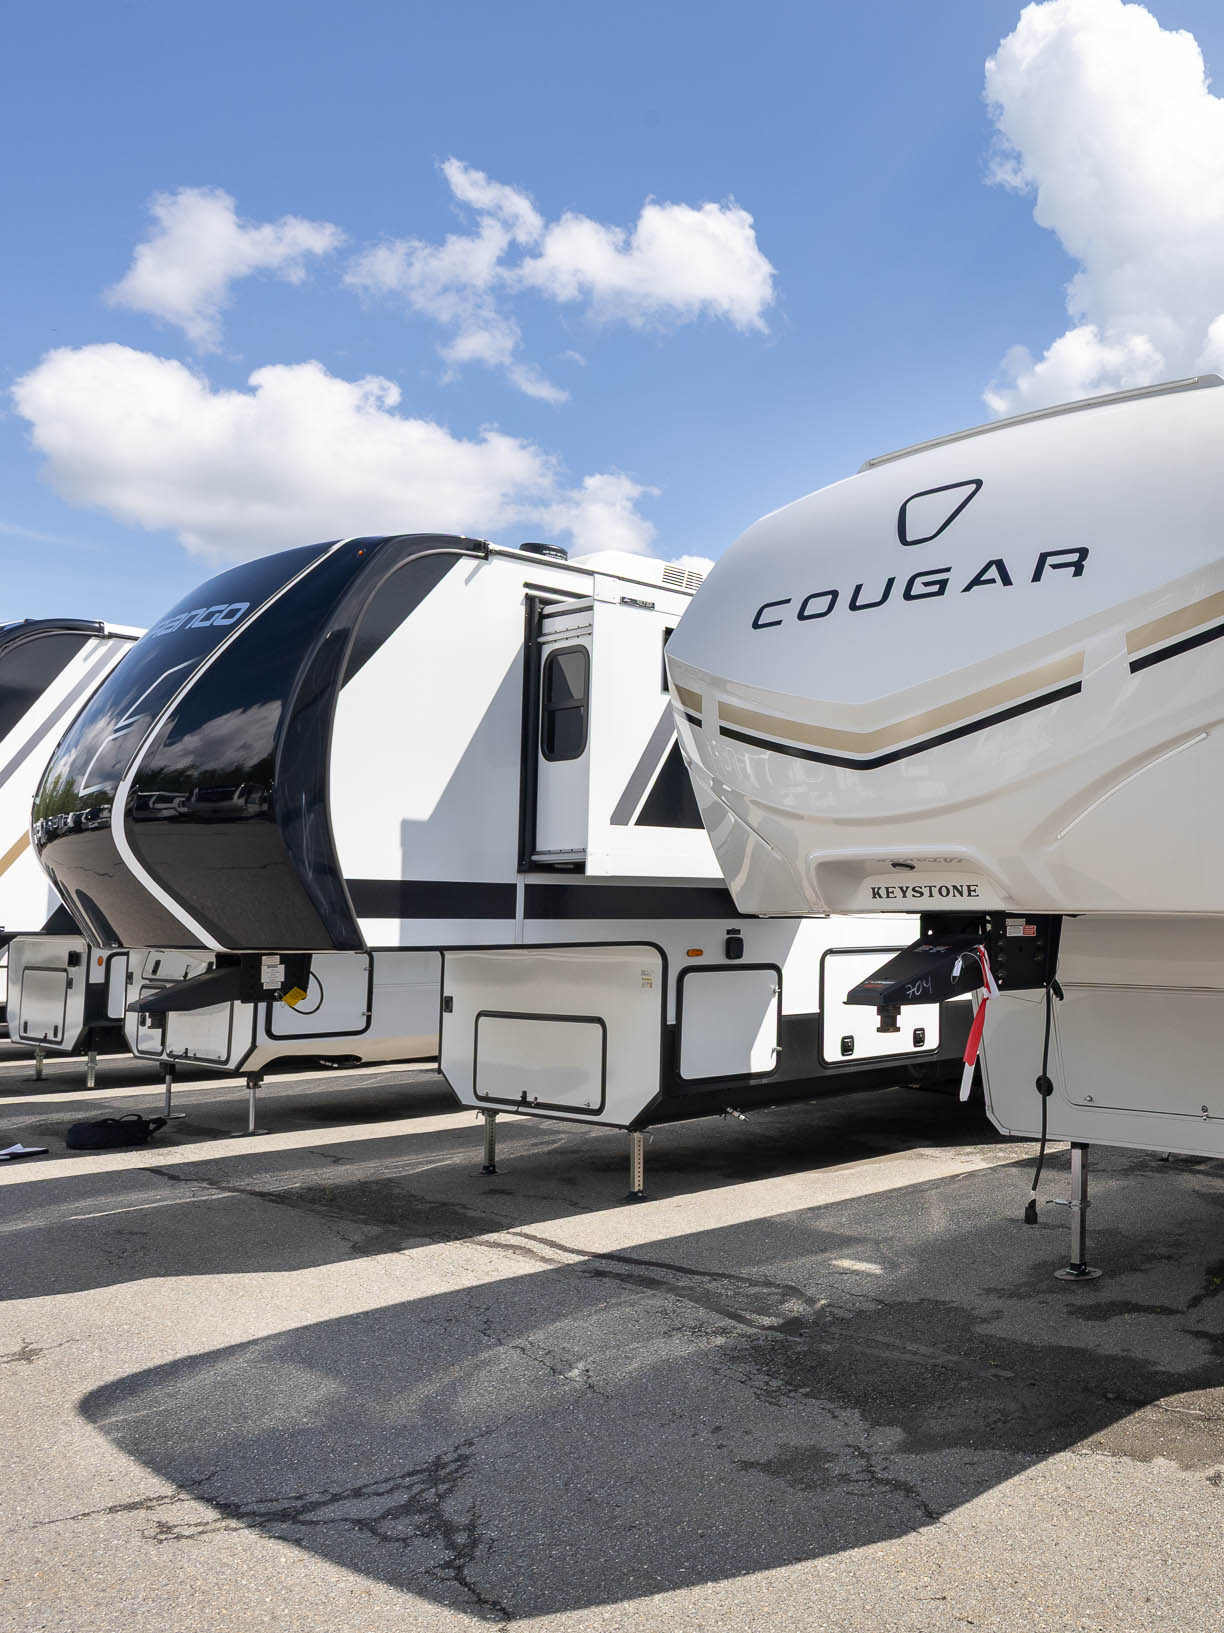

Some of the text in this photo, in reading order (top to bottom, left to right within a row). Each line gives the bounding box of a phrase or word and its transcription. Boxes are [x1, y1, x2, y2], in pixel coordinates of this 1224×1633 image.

[752, 546, 1090, 631] COUGAR
[871, 884, 980, 899] KEYSTONE
[904, 975, 933, 999] 704
